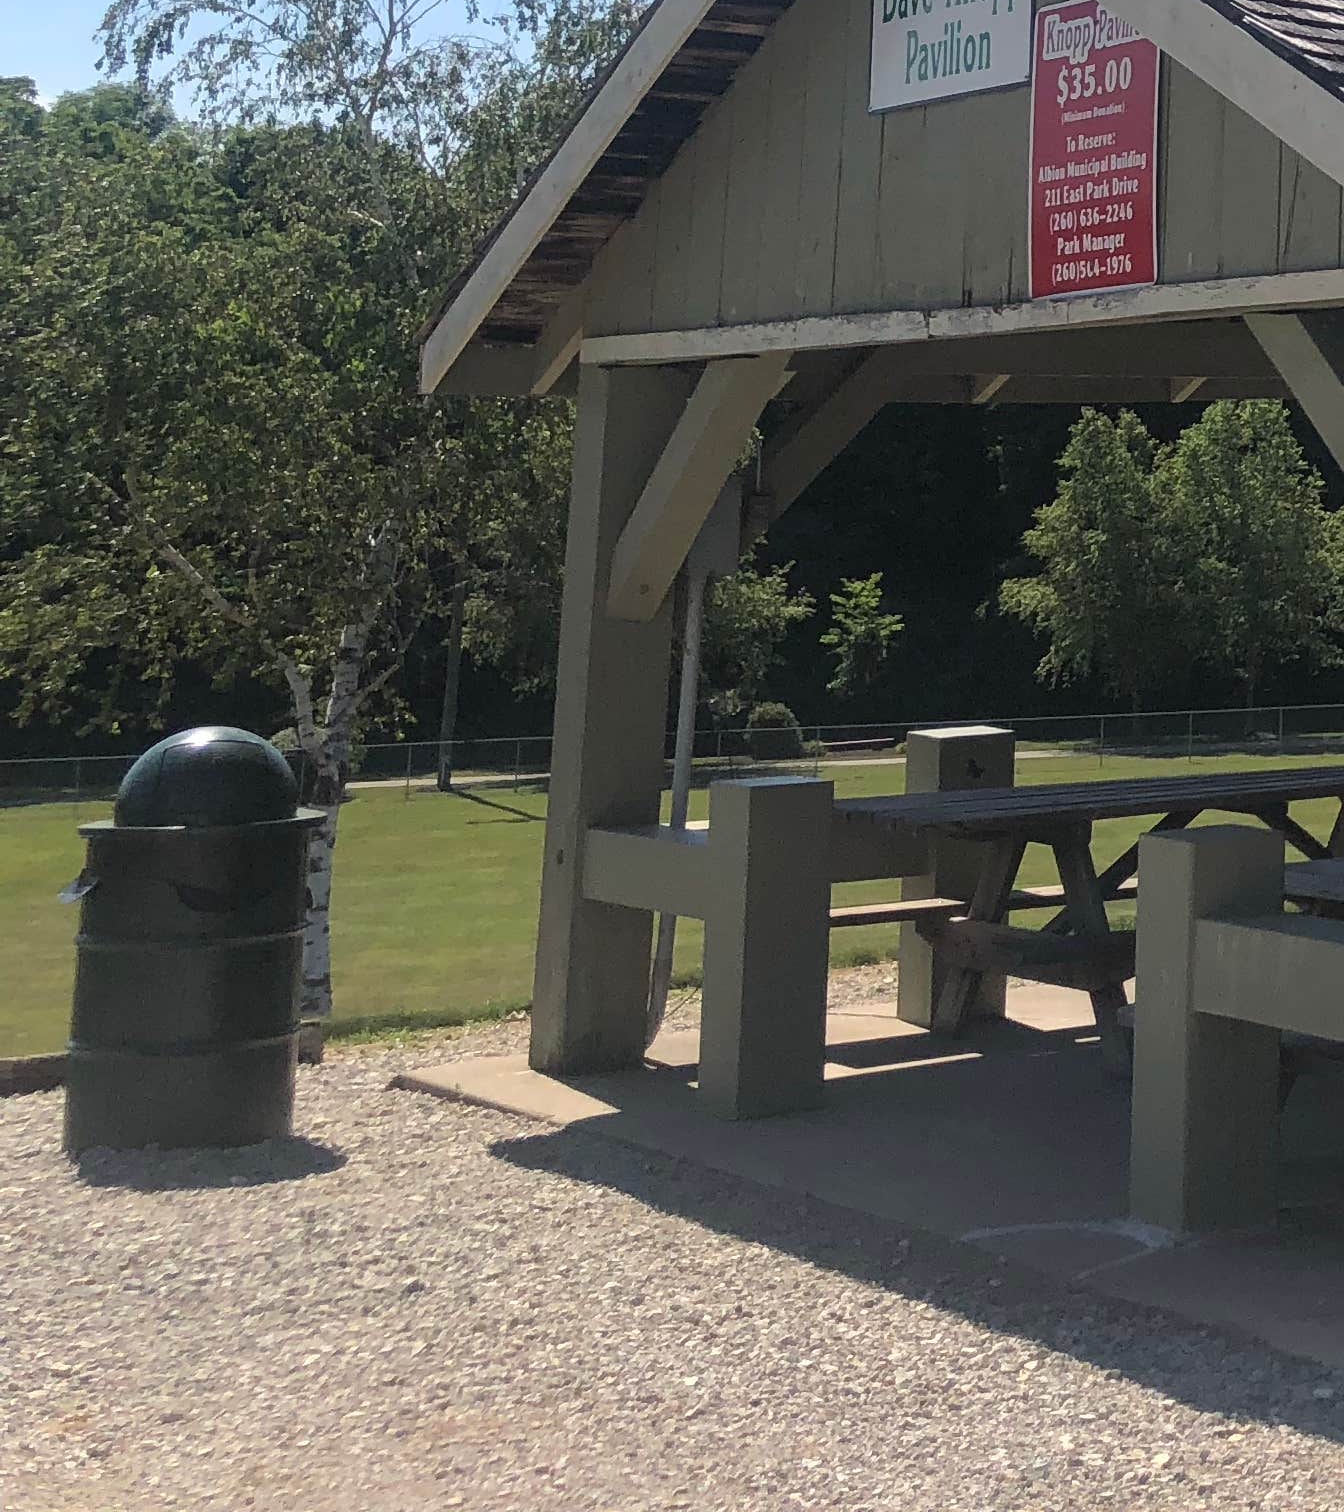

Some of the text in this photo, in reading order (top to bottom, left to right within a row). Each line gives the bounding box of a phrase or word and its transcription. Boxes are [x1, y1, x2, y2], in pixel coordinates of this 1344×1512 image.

[905, 20, 992, 85] Pavilion
[1045, 19, 1092, 60] Knopp
[1056, 56, 1132, 109] $35.00
[1066, 131, 1116, 153] To Reserve:
[1038, 149, 1147, 183] Albion Municipal Building
[1044, 175, 1139, 207] 211 East Park Drive
[1049, 201, 1133, 235] (260) 636-2246
[1057, 233, 1126, 256] Park Manager
